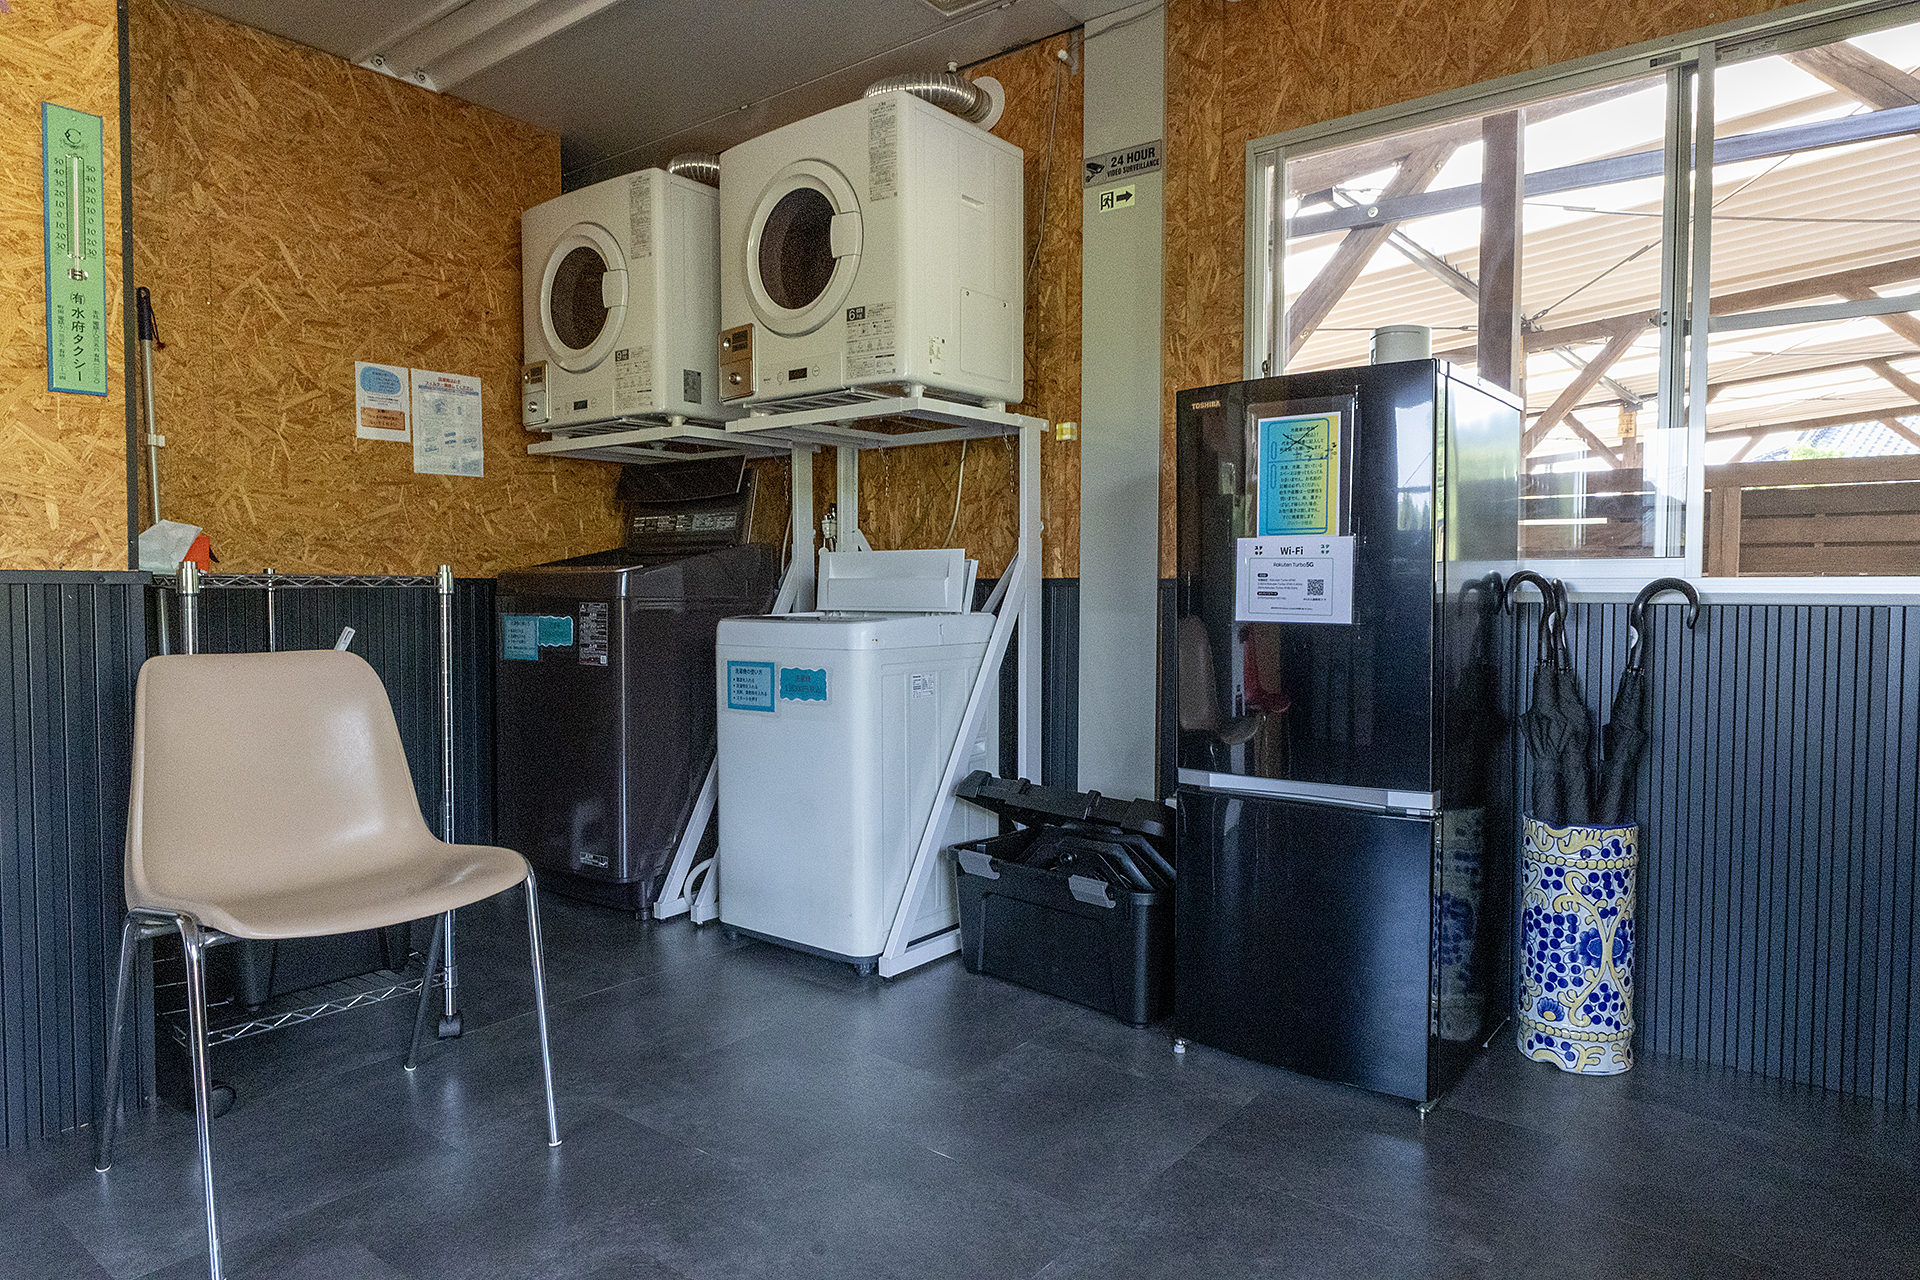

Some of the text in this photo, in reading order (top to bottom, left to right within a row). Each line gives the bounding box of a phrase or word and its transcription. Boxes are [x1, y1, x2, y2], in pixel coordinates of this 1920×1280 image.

[54, 157, 64, 165] 50
[1111, 147, 1156, 168] 24 HOUR
[86, 165, 96, 173] 50
[1107, 158, 1160, 177] VIDEO SURVEILLANCE
[55, 179, 65, 187] 30
[85, 175, 96, 183] 40
[54, 189, 65, 197] 20
[86, 186, 96, 194] 30
[55, 200, 65, 208] 10
[56, 210, 62, 218] 0
[87, 207, 96, 215] 10
[56, 221, 65, 229] 10
[56, 232, 66, 240] 20
[87, 228, 96, 236] 10
[87, 238, 97, 246] 20
[1191, 400, 1221, 410] TOSHIBA
[1280, 545, 1304, 555] Wi-Fi
